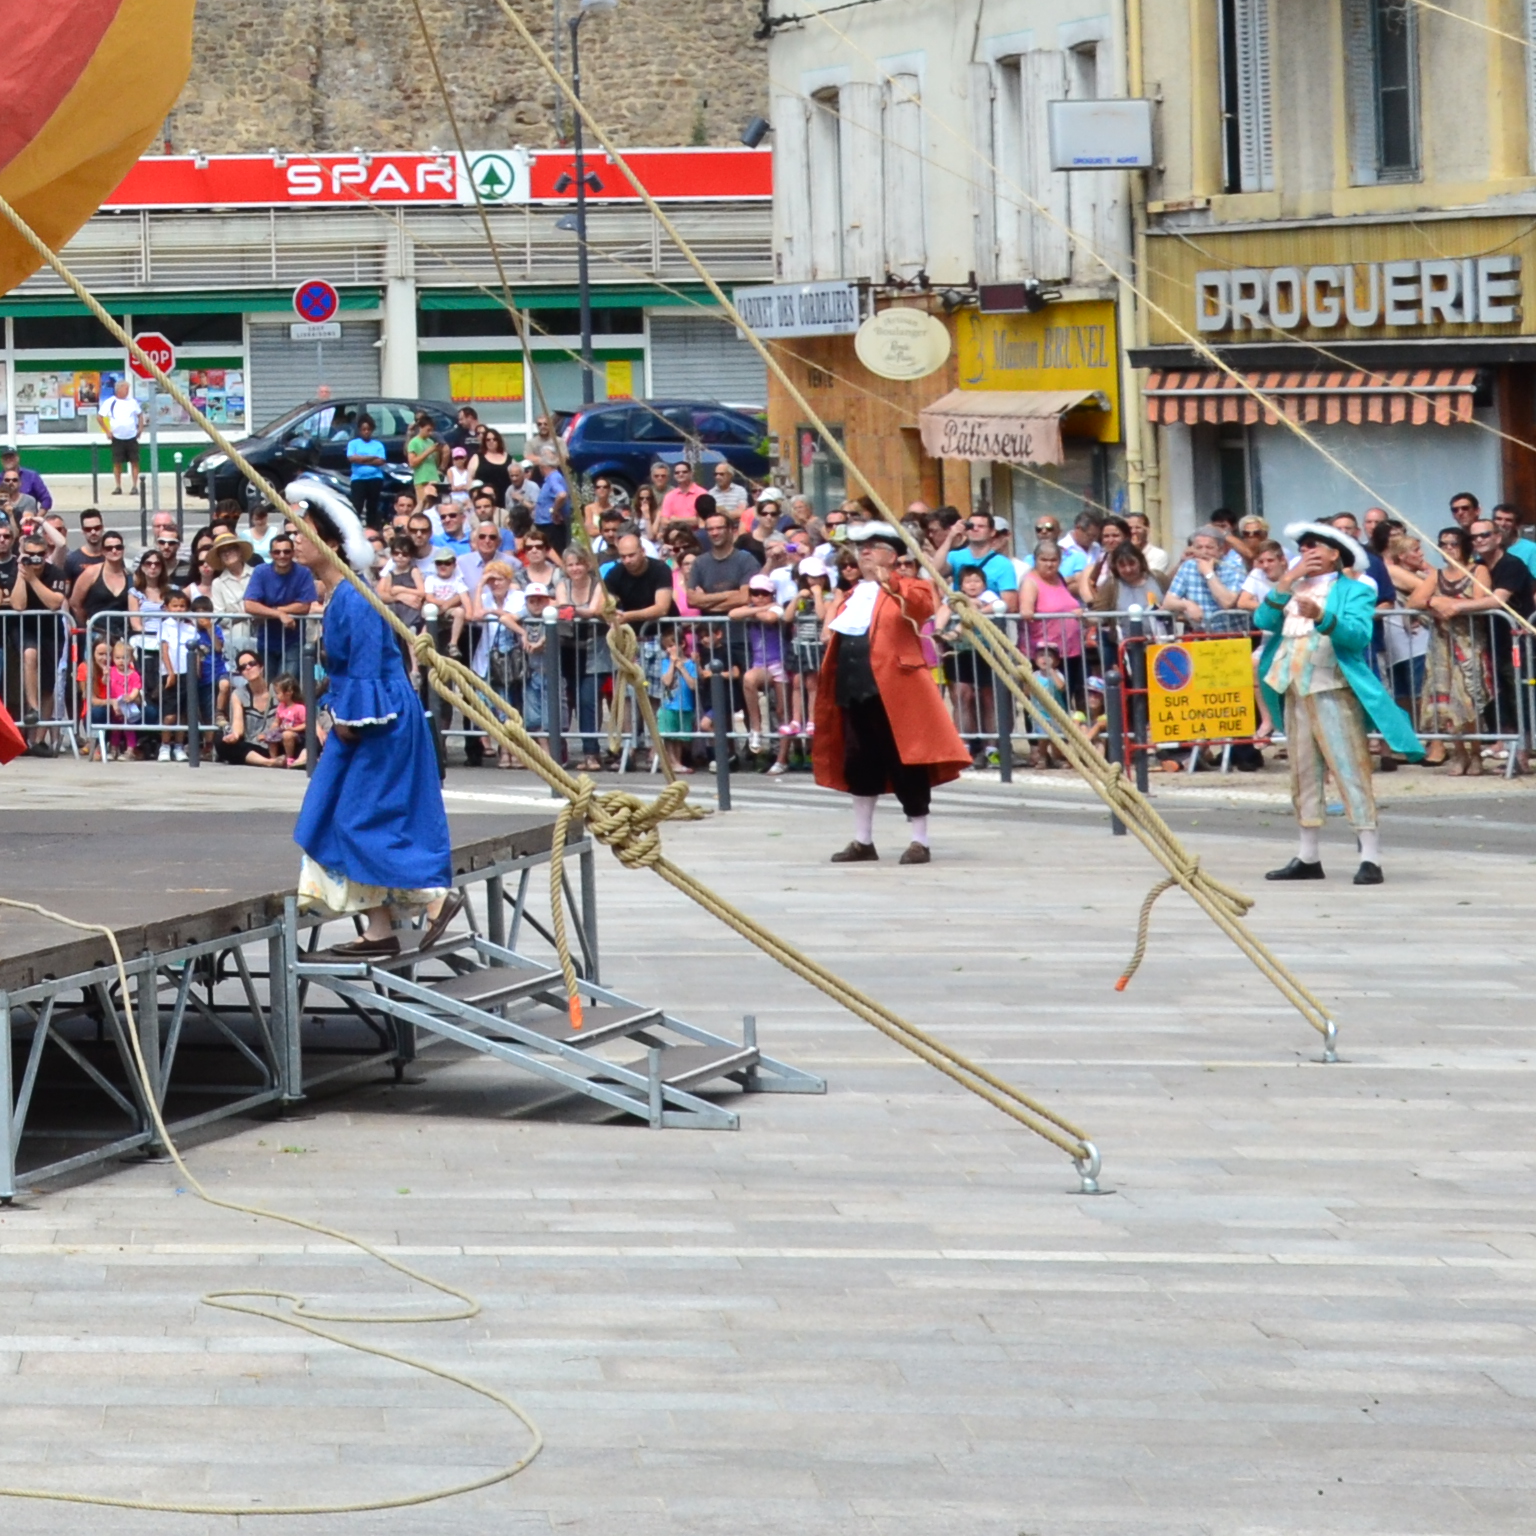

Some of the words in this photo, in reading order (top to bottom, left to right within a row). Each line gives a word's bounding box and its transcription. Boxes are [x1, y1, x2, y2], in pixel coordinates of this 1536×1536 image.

[286, 163, 454, 195] SPAR
[1195, 255, 1520, 332] DROGUERIE
[132, 350, 169, 365] SOP
[993, 329, 1039, 369] Maison
[1043, 325, 1108, 369] BRUNEL
[941, 419, 1034, 457] Pâtisserie
[1164, 696, 1189, 707] SUR
[1203, 692, 1240, 704] TOUTE
[1159, 712, 1174, 722] LA
[1181, 707, 1247, 721] LONGUEUR
[1164, 725, 1179, 736] DE
[1192, 723, 1206, 734] LA
[1219, 720, 1242, 731] RUE
